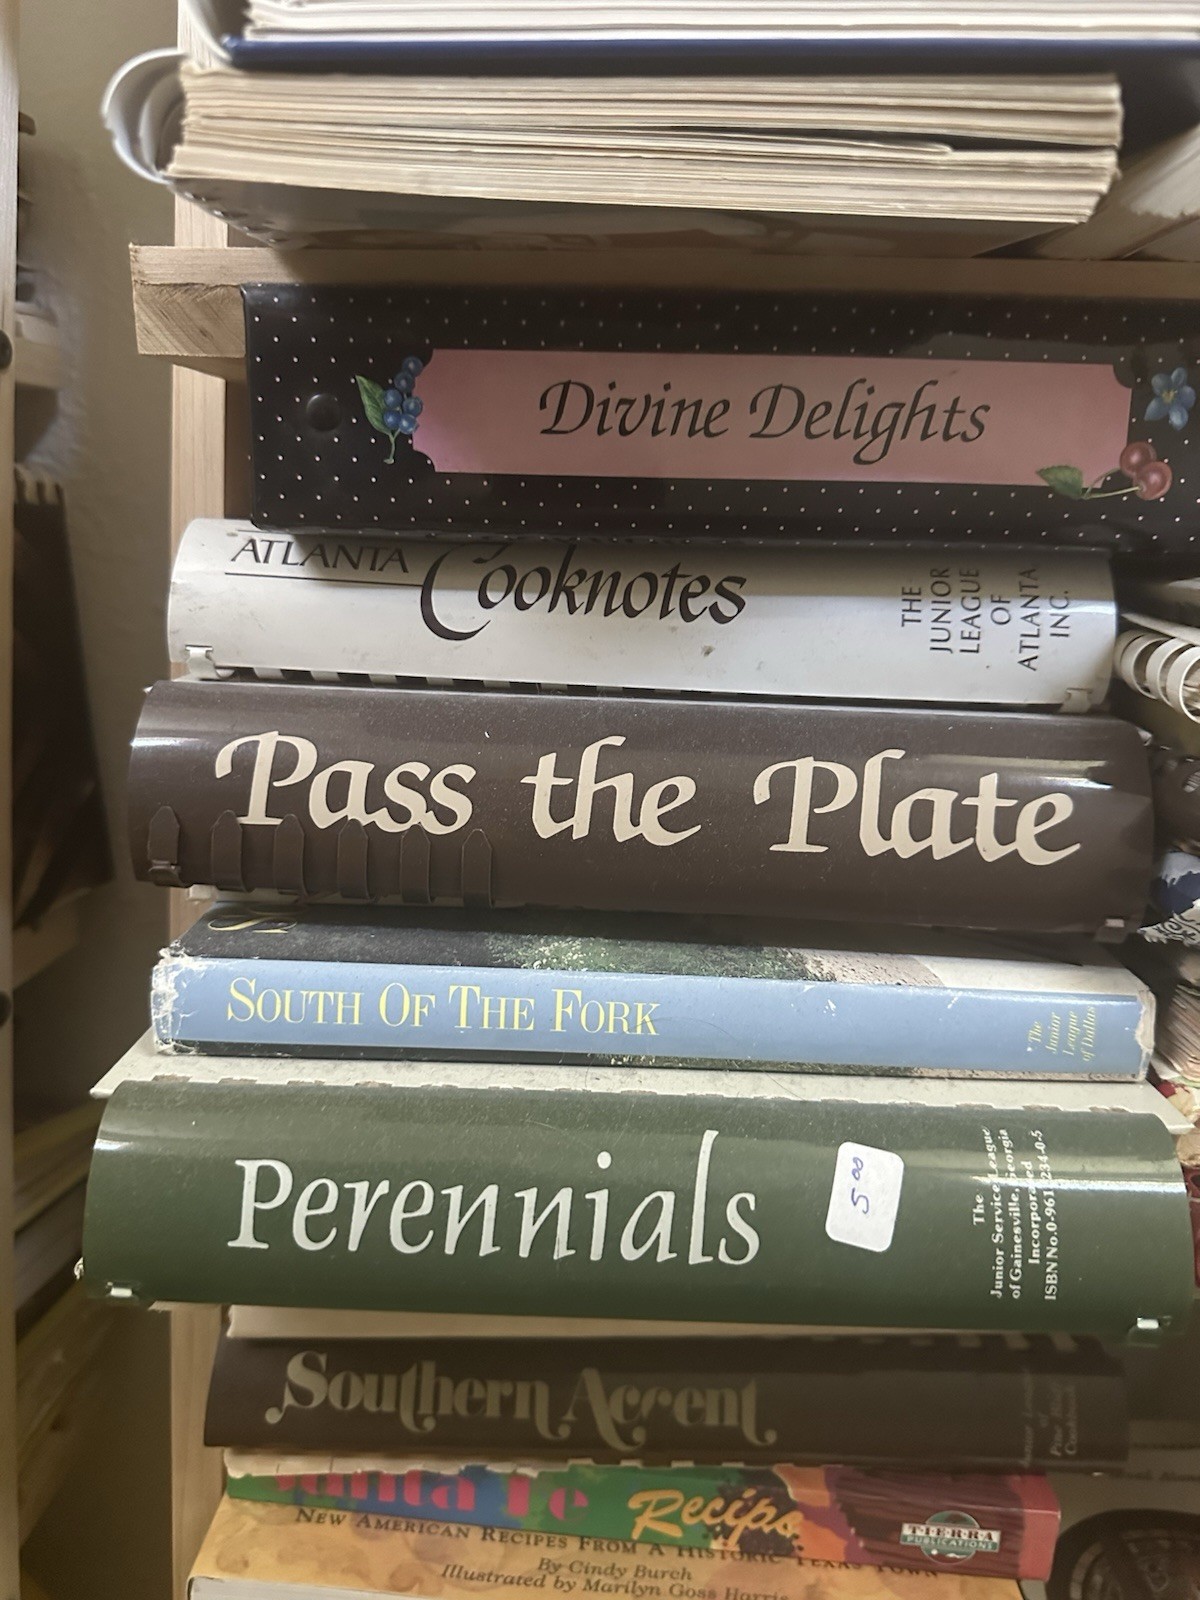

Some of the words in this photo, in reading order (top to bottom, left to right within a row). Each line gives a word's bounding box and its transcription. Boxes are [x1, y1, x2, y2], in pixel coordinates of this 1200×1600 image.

[539, 379, 731, 438] Divine
[748, 377, 991, 466] Delights
[230, 537, 410, 574] ATLANTA
[420, 542, 748, 641] Cooknotes
[901, 586, 922, 627] THE
[930, 568, 953, 654] JUNIOR
[959, 568, 981, 654] LEAGUE
[990, 594, 1012, 626] OF
[1017, 568, 1041, 672] ATLANTA
[1050, 590, 1071, 638] INC.
[215, 730, 477, 836] Pass
[520, 735, 702, 847] the
[754, 748, 1082, 866] Plate
[227, 976, 363, 1026] SOUTH
[379, 981, 436, 1028] OF
[449, 984, 535, 1031] THE
[550, 988, 660, 1037] FORK
[228, 1130, 760, 1265] Perennials
[972, 1193, 985, 1226] The
[990, 1184, 1004, 1243] Service
[1021, 1160, 1041, 1265] Incorporaed
[990, 1248, 1004, 1299] Junior
[1008, 1284, 1021, 1299] of
[1044, 1261, 1058, 1300] ISBN
[265, 1350, 571, 1440] Southern
[441, 1564, 546, 1588] Illustrated
[554, 1575, 577, 1593] by
[538, 1556, 562, 1575] By
[569, 1559, 627, 1579] Cindy
[634, 1564, 692, 1581] Burch
